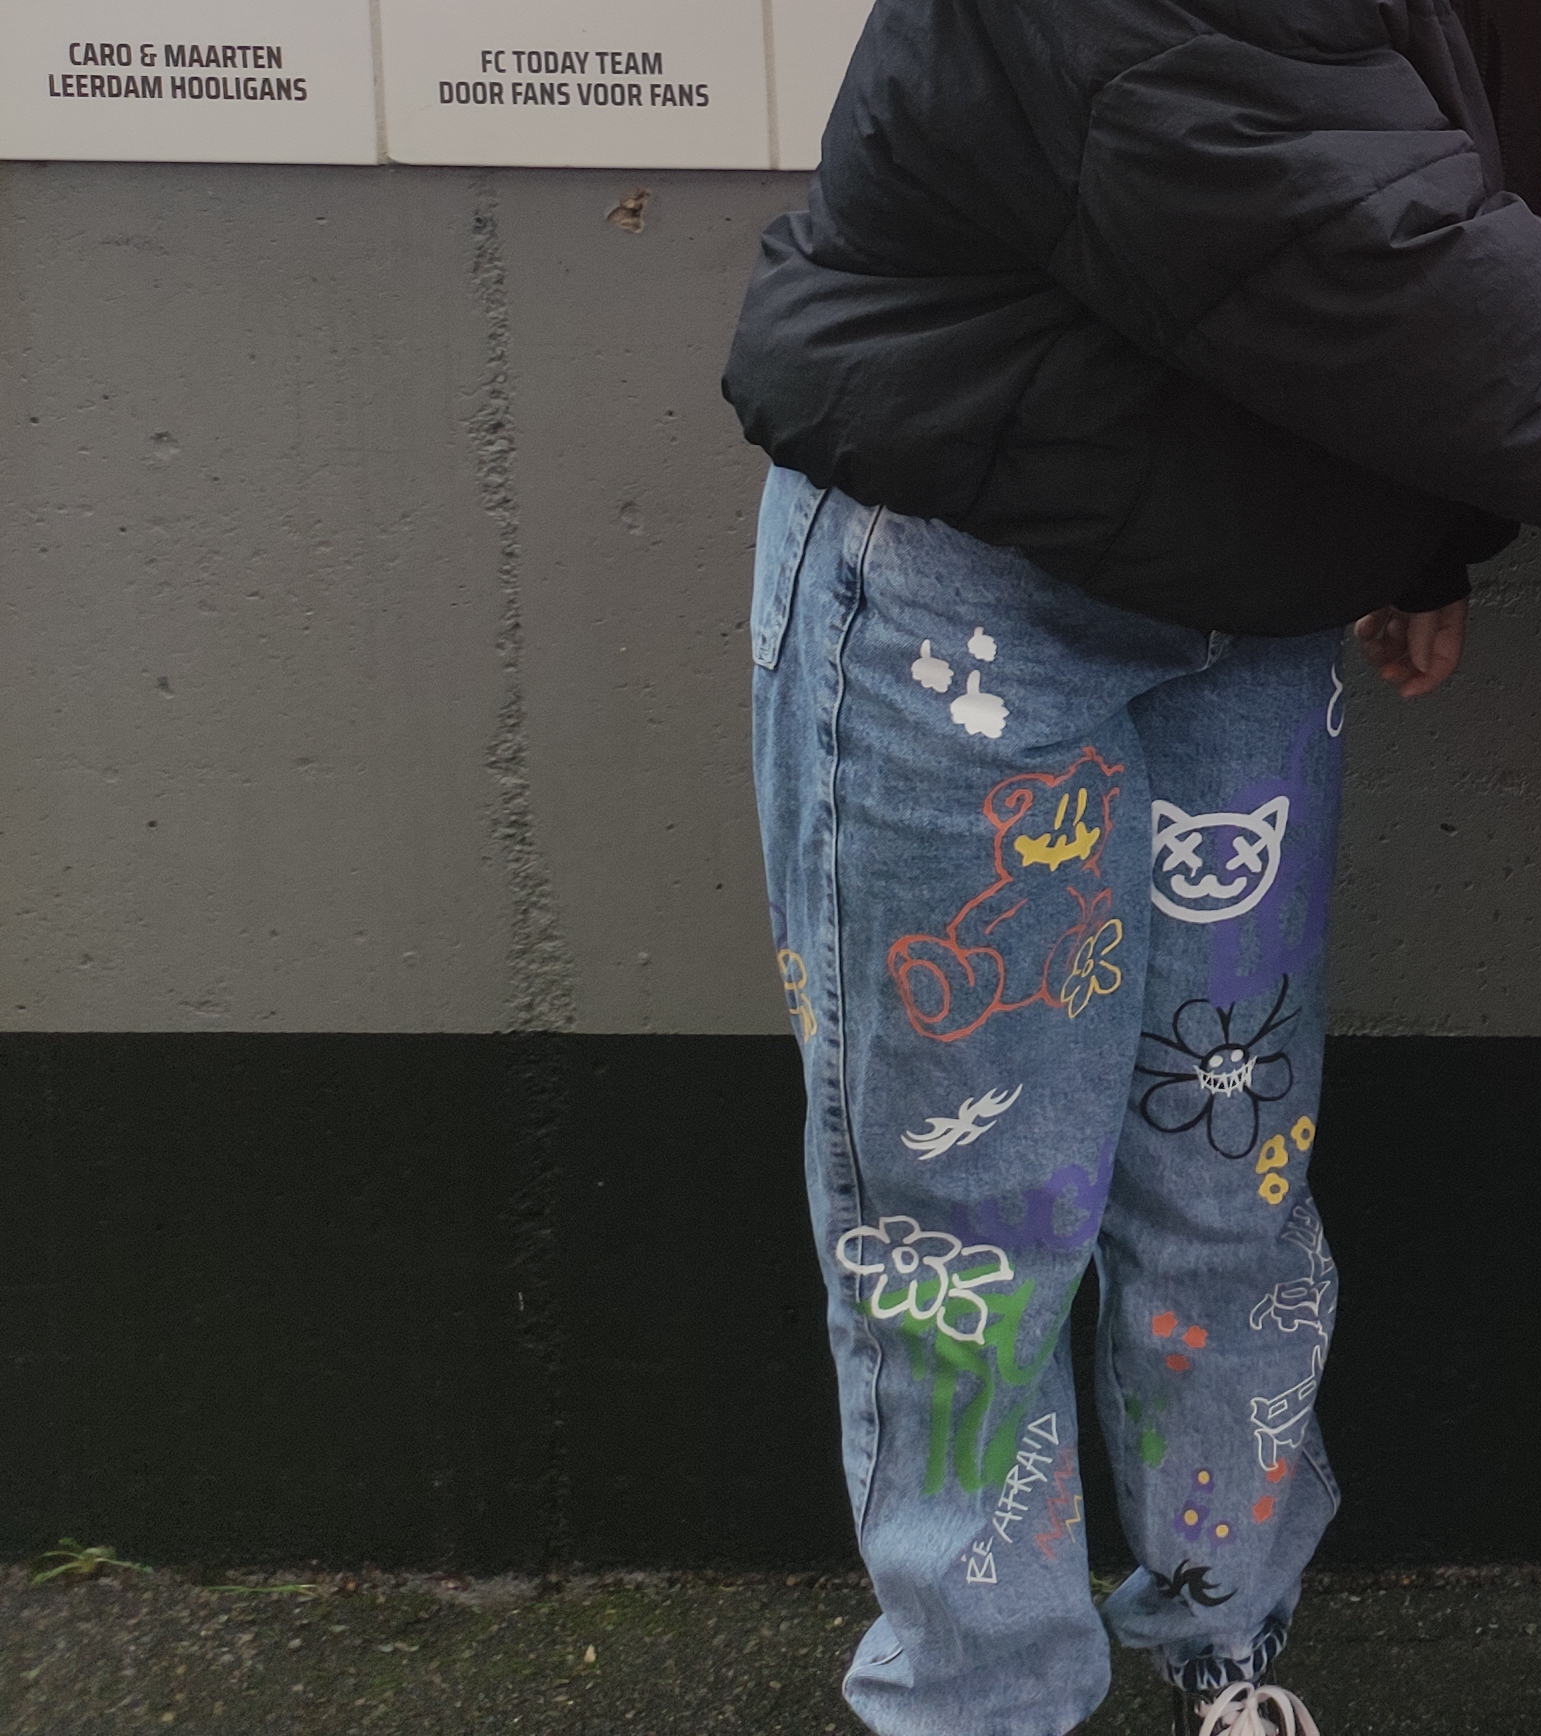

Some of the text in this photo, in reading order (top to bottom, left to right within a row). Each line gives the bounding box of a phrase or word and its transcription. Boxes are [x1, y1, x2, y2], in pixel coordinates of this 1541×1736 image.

[69, 42, 283, 69] CARO & MAARTEN
[481, 50, 663, 75] FC TODAY TEAM
[48, 73, 308, 102] LEERDAM HOOLIGANS
[439, 81, 709, 107] DOOR FANS VOOR FANS
